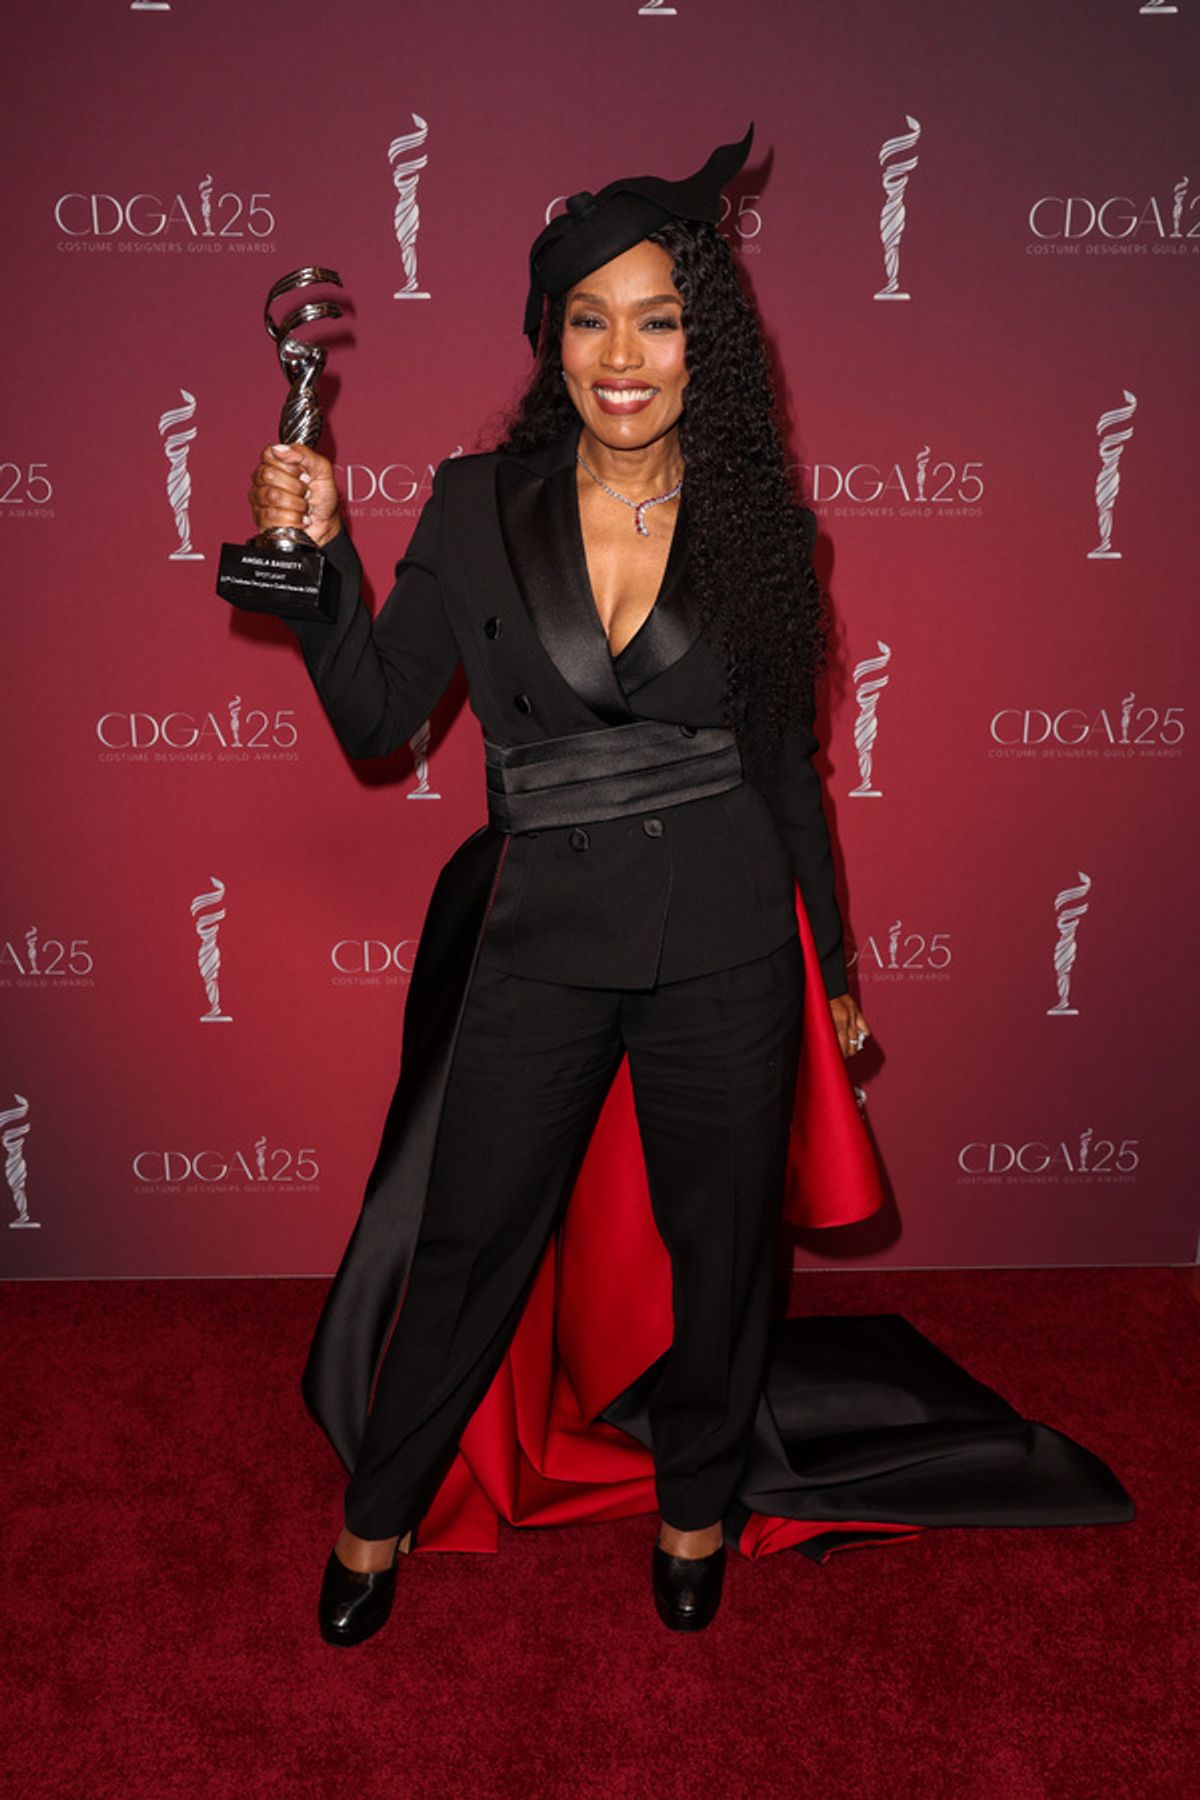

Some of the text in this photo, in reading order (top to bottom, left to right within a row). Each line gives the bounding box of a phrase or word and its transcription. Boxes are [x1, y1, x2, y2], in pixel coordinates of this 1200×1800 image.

[56, 242, 276, 254] COSTUME DESIGNERS GUILD AWARDS
[1026, 244, 1081, 255] COSTUME
[1086, 244, 1148, 255] DESIGNERS
[1152, 244, 1188, 254] GUILD
[335, 464, 435, 503] DGA
[8, 509, 55, 518] AWARDS
[370, 508, 421, 518] DESIGNE
[834, 507, 894, 517] DESIGNERS
[899, 507, 931, 516] GUILD
[937, 507, 984, 517] AWARDS
[99, 752, 299, 762] COSTUME DESIGNERS GUILD AWARDS
[988, 749, 1037, 759] COSTUME
[331, 940, 419, 973] CDG
